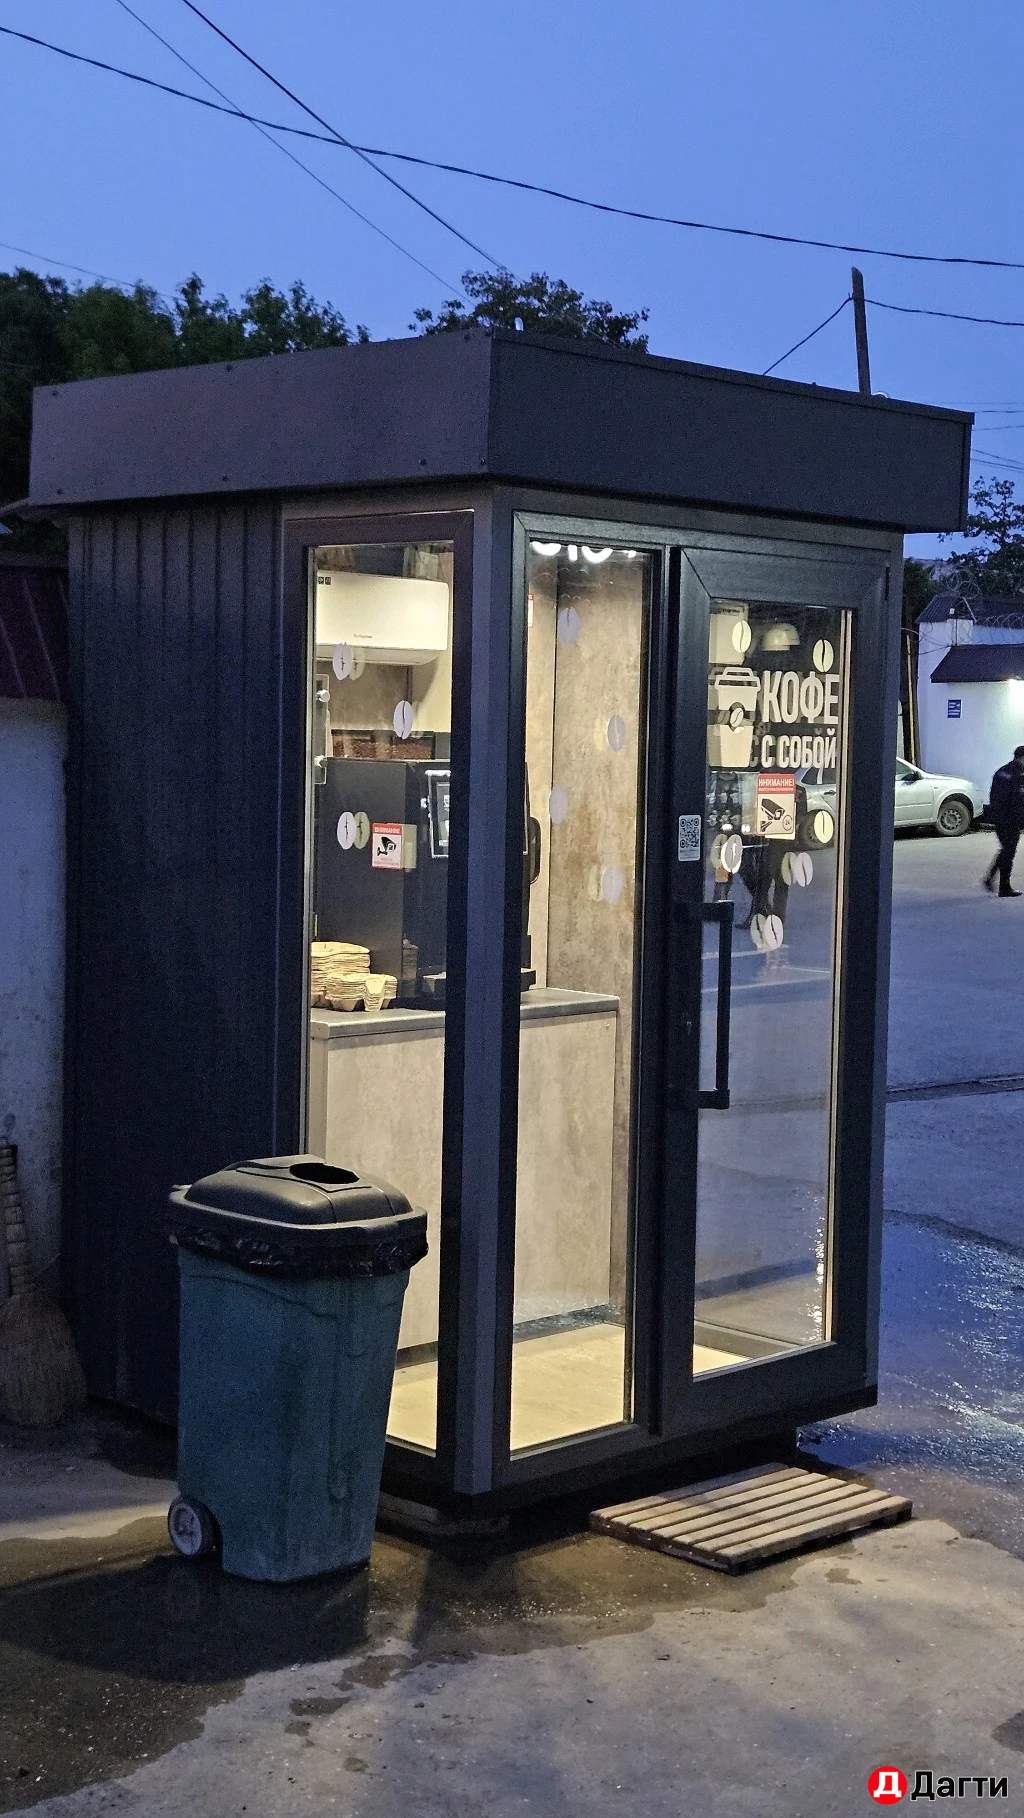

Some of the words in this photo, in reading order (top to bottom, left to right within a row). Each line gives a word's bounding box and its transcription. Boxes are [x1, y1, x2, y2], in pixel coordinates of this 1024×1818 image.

[762, 670, 840, 725] КОФЕ
[761, 735, 774, 768] С
[779, 727, 837, 769] СОБОЙ
